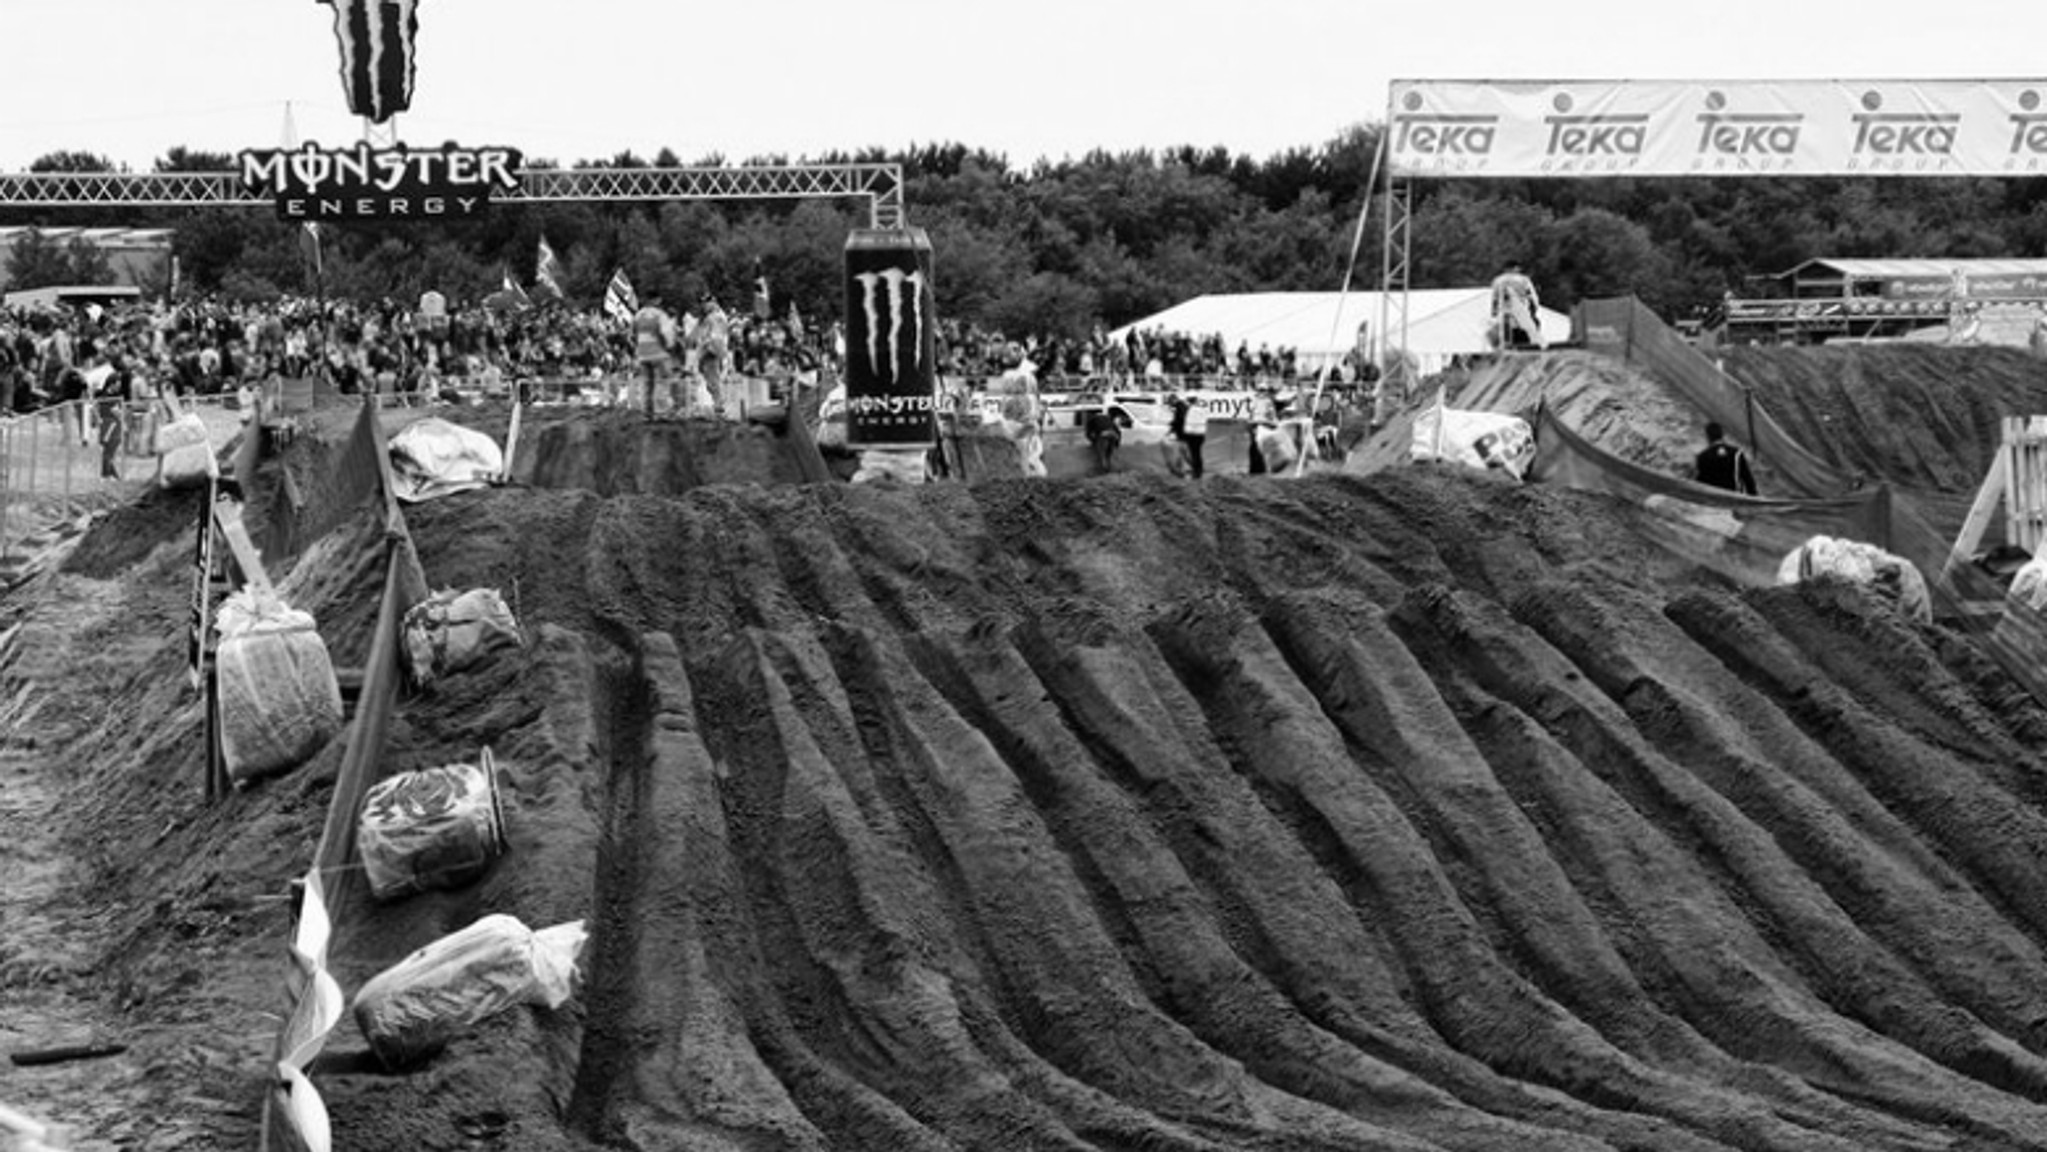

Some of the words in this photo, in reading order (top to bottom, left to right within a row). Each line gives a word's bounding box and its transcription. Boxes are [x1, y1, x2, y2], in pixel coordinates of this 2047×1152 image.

[242, 142, 519, 193] MONSTER
[287, 199, 477, 215] ENERGY
[848, 393, 935, 415] MONSTE
